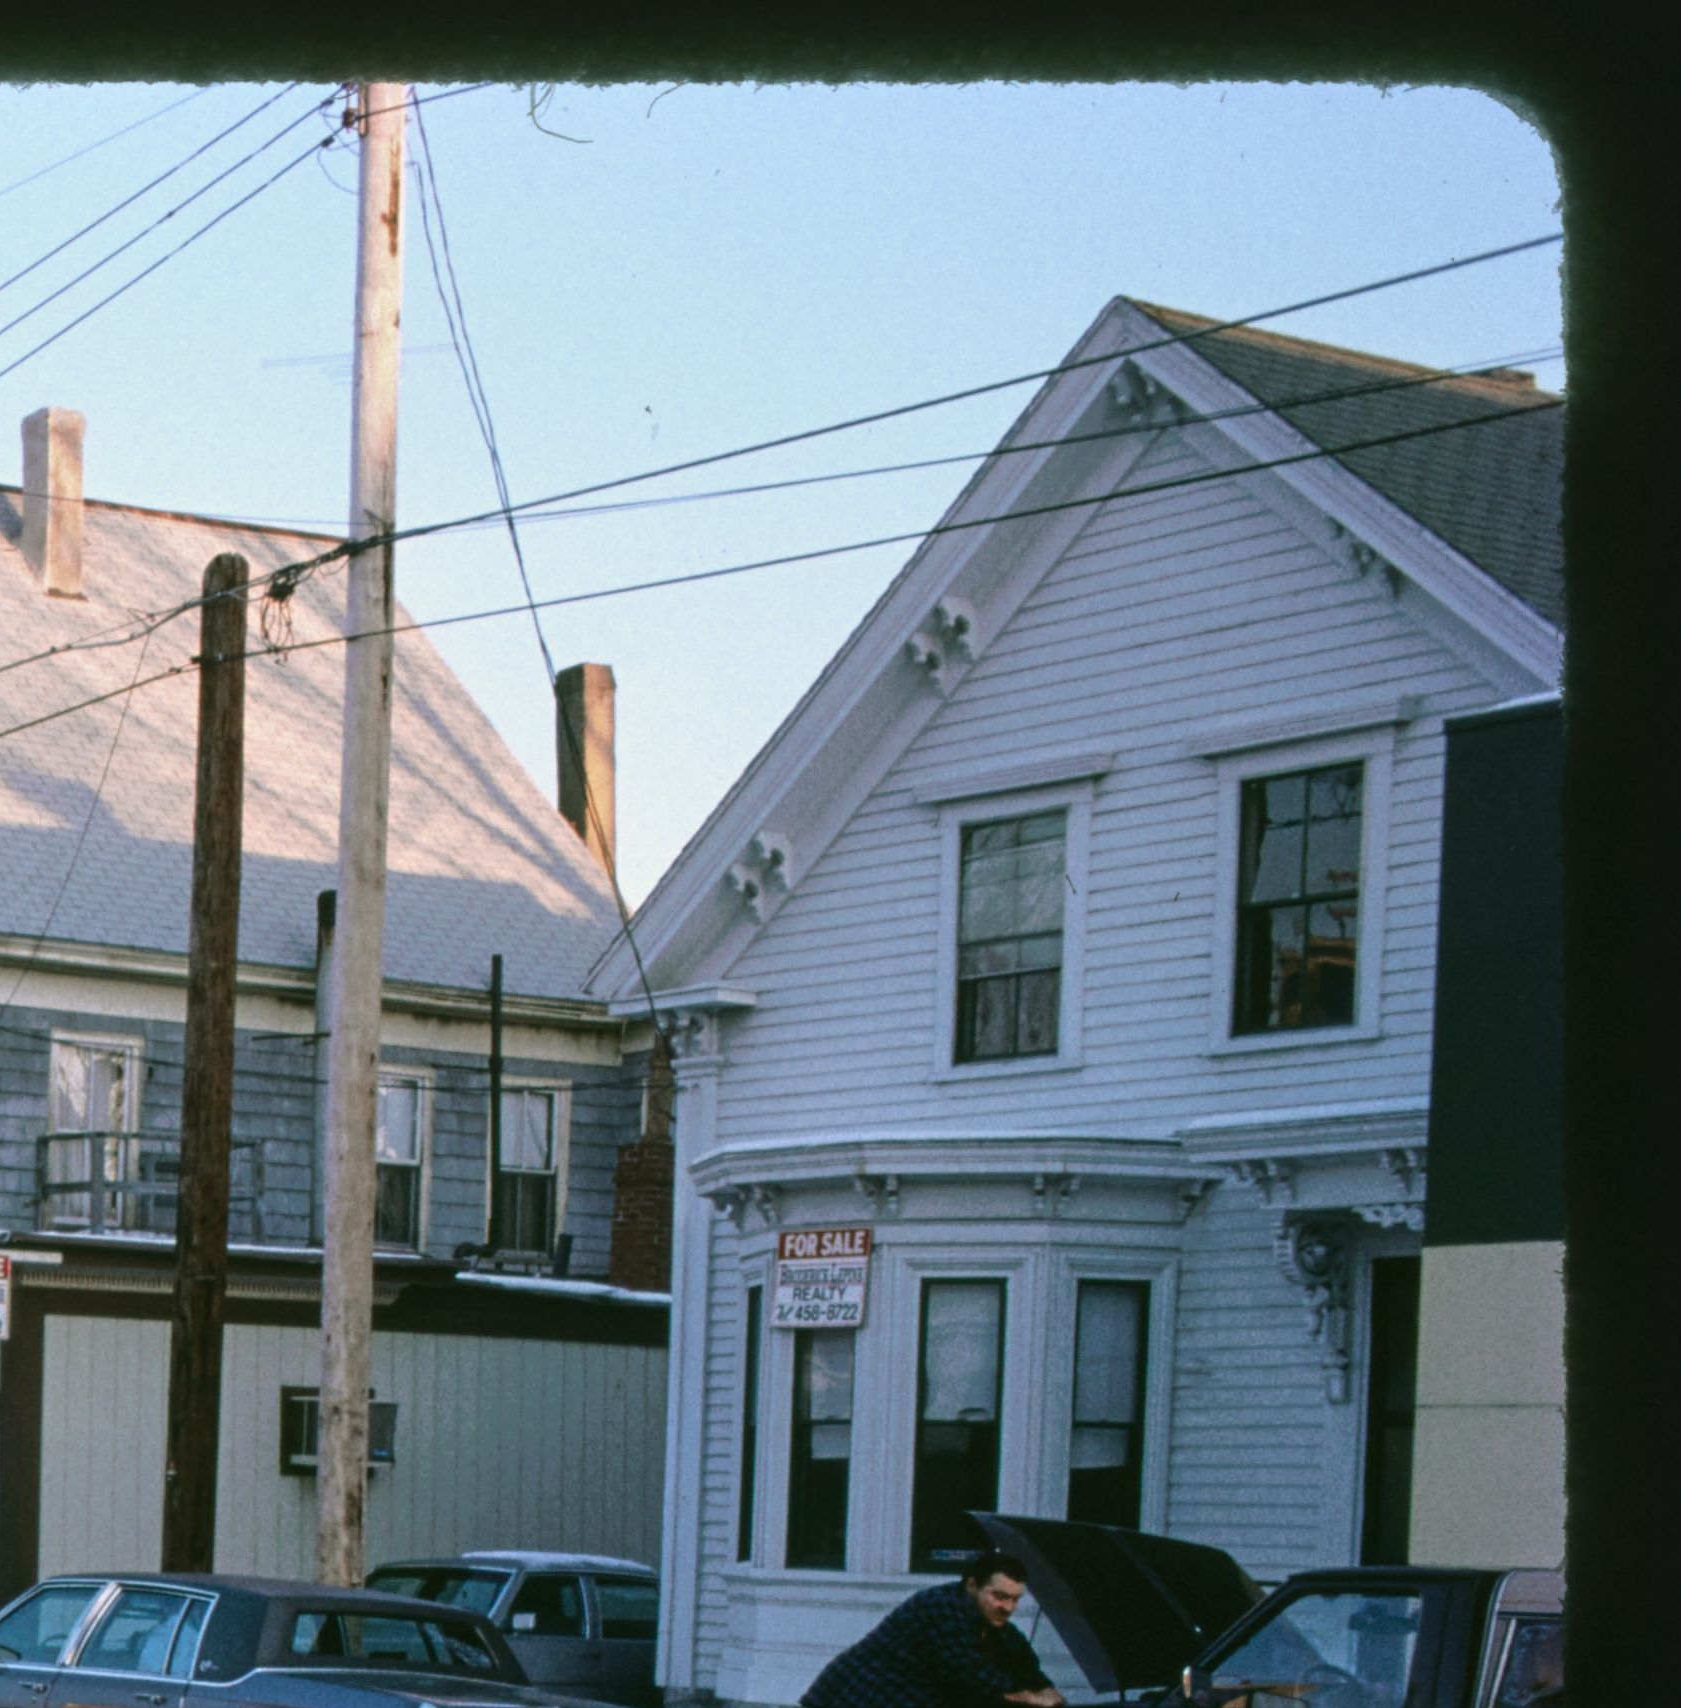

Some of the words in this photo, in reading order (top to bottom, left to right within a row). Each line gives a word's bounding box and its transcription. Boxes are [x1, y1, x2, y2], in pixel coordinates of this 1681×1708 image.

[784, 1233, 818, 1257] FOR
[820, 1231, 866, 1256] SALE
[792, 1287, 846, 1301] REALTY
